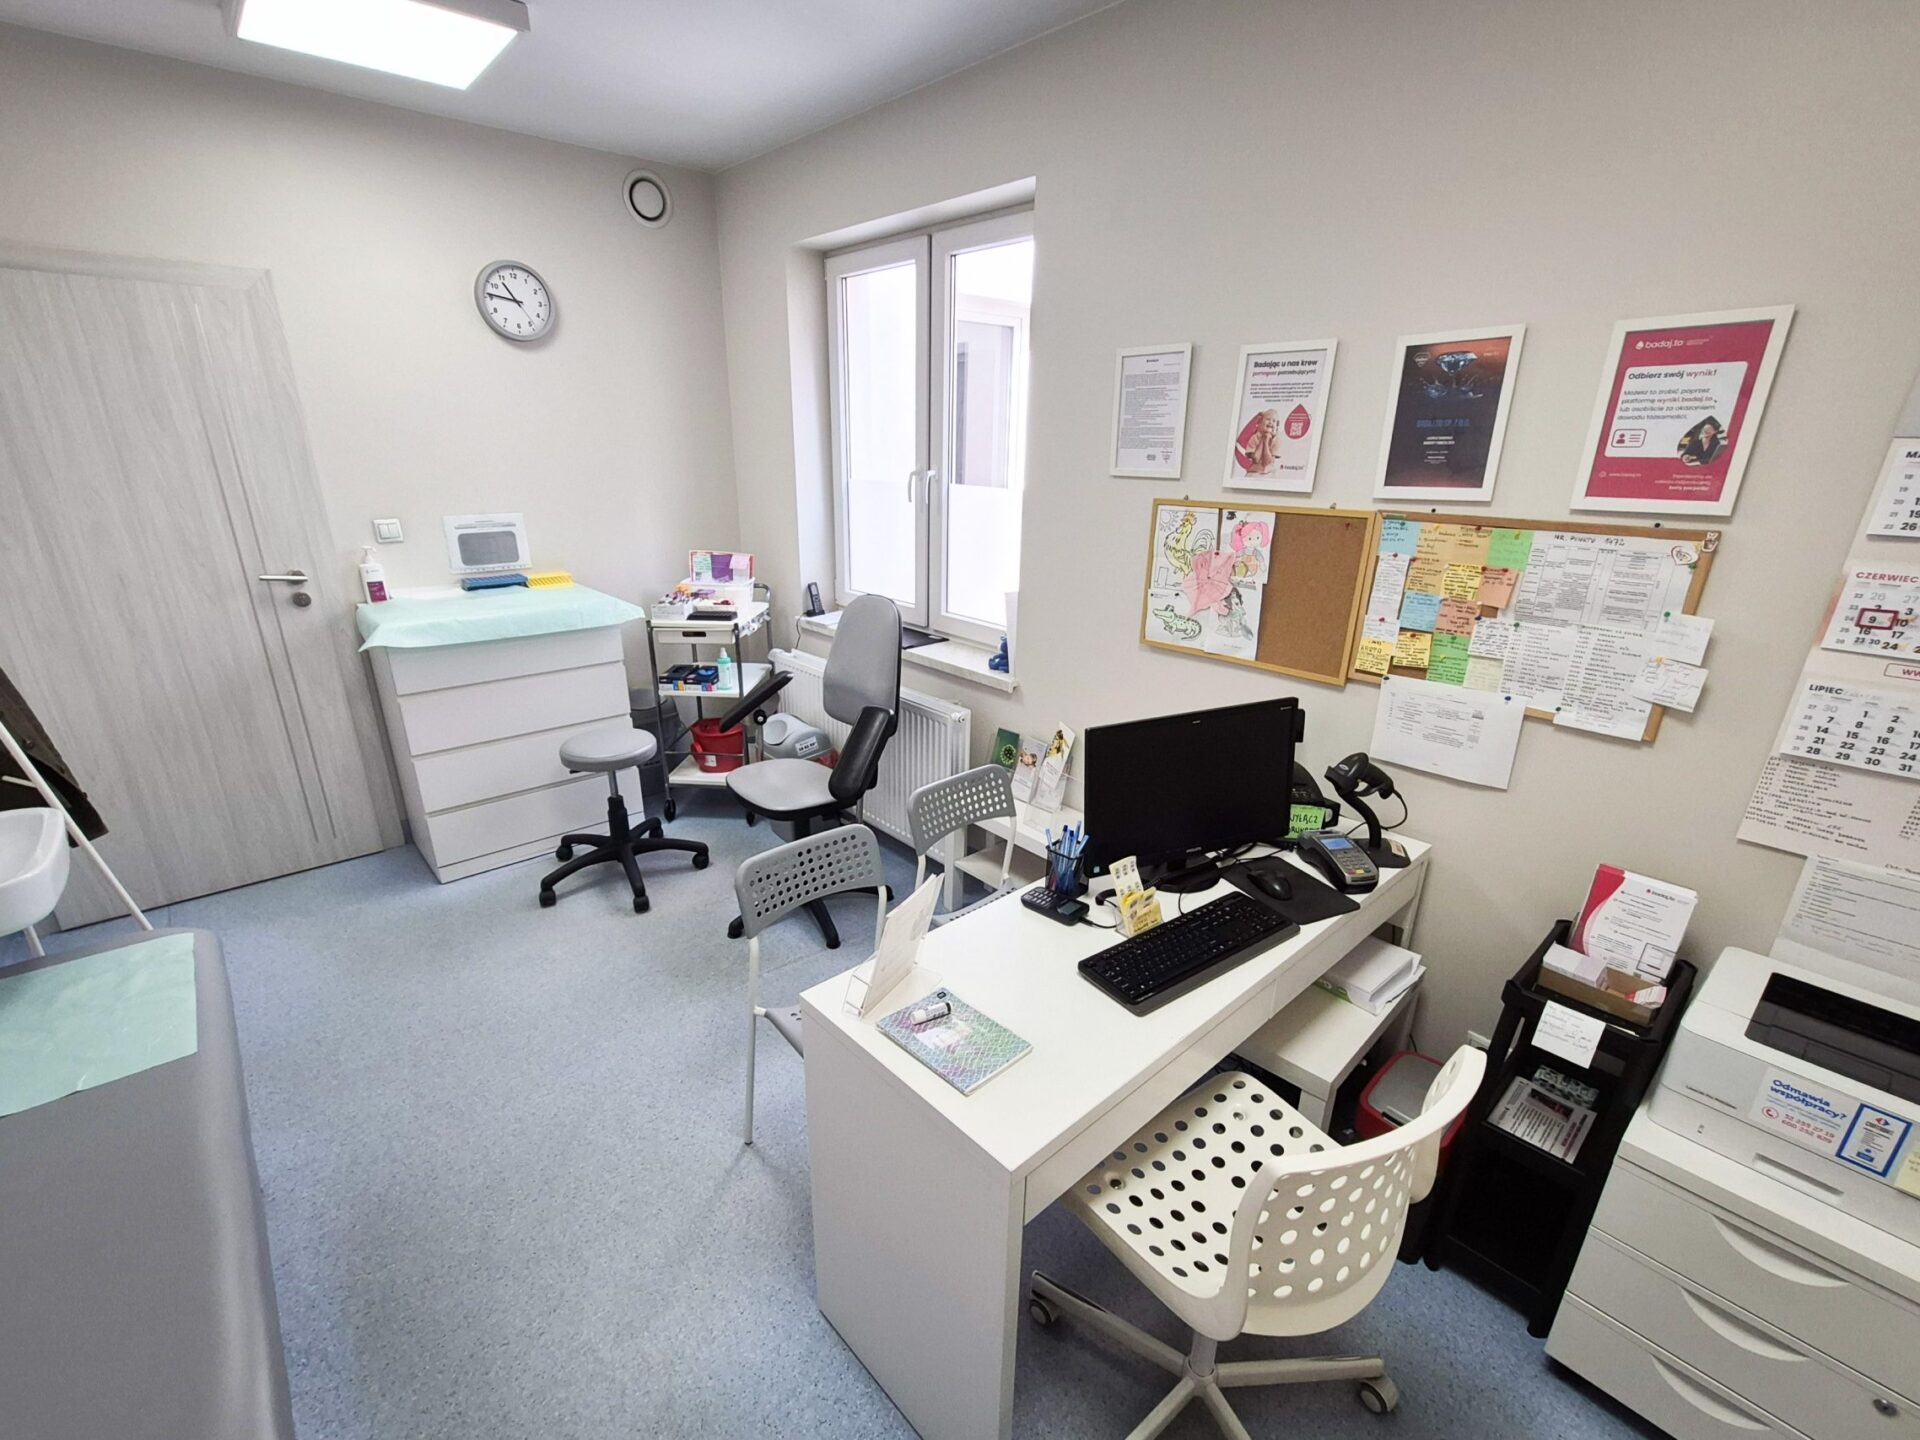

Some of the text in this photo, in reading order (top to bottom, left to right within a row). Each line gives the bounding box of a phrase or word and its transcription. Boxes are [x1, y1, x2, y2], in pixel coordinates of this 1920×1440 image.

[1645, 339, 1684, 348] badaj.to
[1254, 360, 1280, 369] Badając
[1663, 370, 1685, 379] swój
[1686, 369, 1717, 378] wynik!
[1680, 388, 1711, 397] poprzez
[1909, 509, 1920, 519] 19
[1900, 522, 1918, 531] 26
[1856, 571, 1919, 583] CZERWIEC
[1904, 608, 1914, 616] 3
[1868, 615, 1877, 623] 9
[1895, 618, 1908, 627] 10
[1859, 626, 1871, 635] 16
[1891, 630, 1905, 639] 17
[1854, 636, 1866, 644] 23
[1881, 641, 1899, 650] 24
[1809, 684, 1844, 695] LIPIEC
[1822, 704, 1838, 713] 30
[1890, 715, 1900, 723] 2
[1826, 716, 1834, 724] 7
[1855, 721, 1864, 729] 8
[1886, 726, 1895, 734] 9
[1816, 725, 1829, 734] 14
[1846, 730, 1859, 740] 15
[1876, 736, 1890, 745] 16
[1909, 741, 1920, 750] 17
[1812, 736, 1825, 745] 21
[1840, 741, 1855, 750] 22
[1869, 746, 1886, 755] 23
[1899, 752, 1917, 761] 24
[1805, 746, 1821, 756] 28
[1835, 752, 1850, 761] 29
[1864, 757, 1881, 766] 30
[1898, 764, 1913, 773] 31
[1773, 1079, 1830, 1107] Odmawia
[1770, 1086, 1847, 1120] współpracy?
